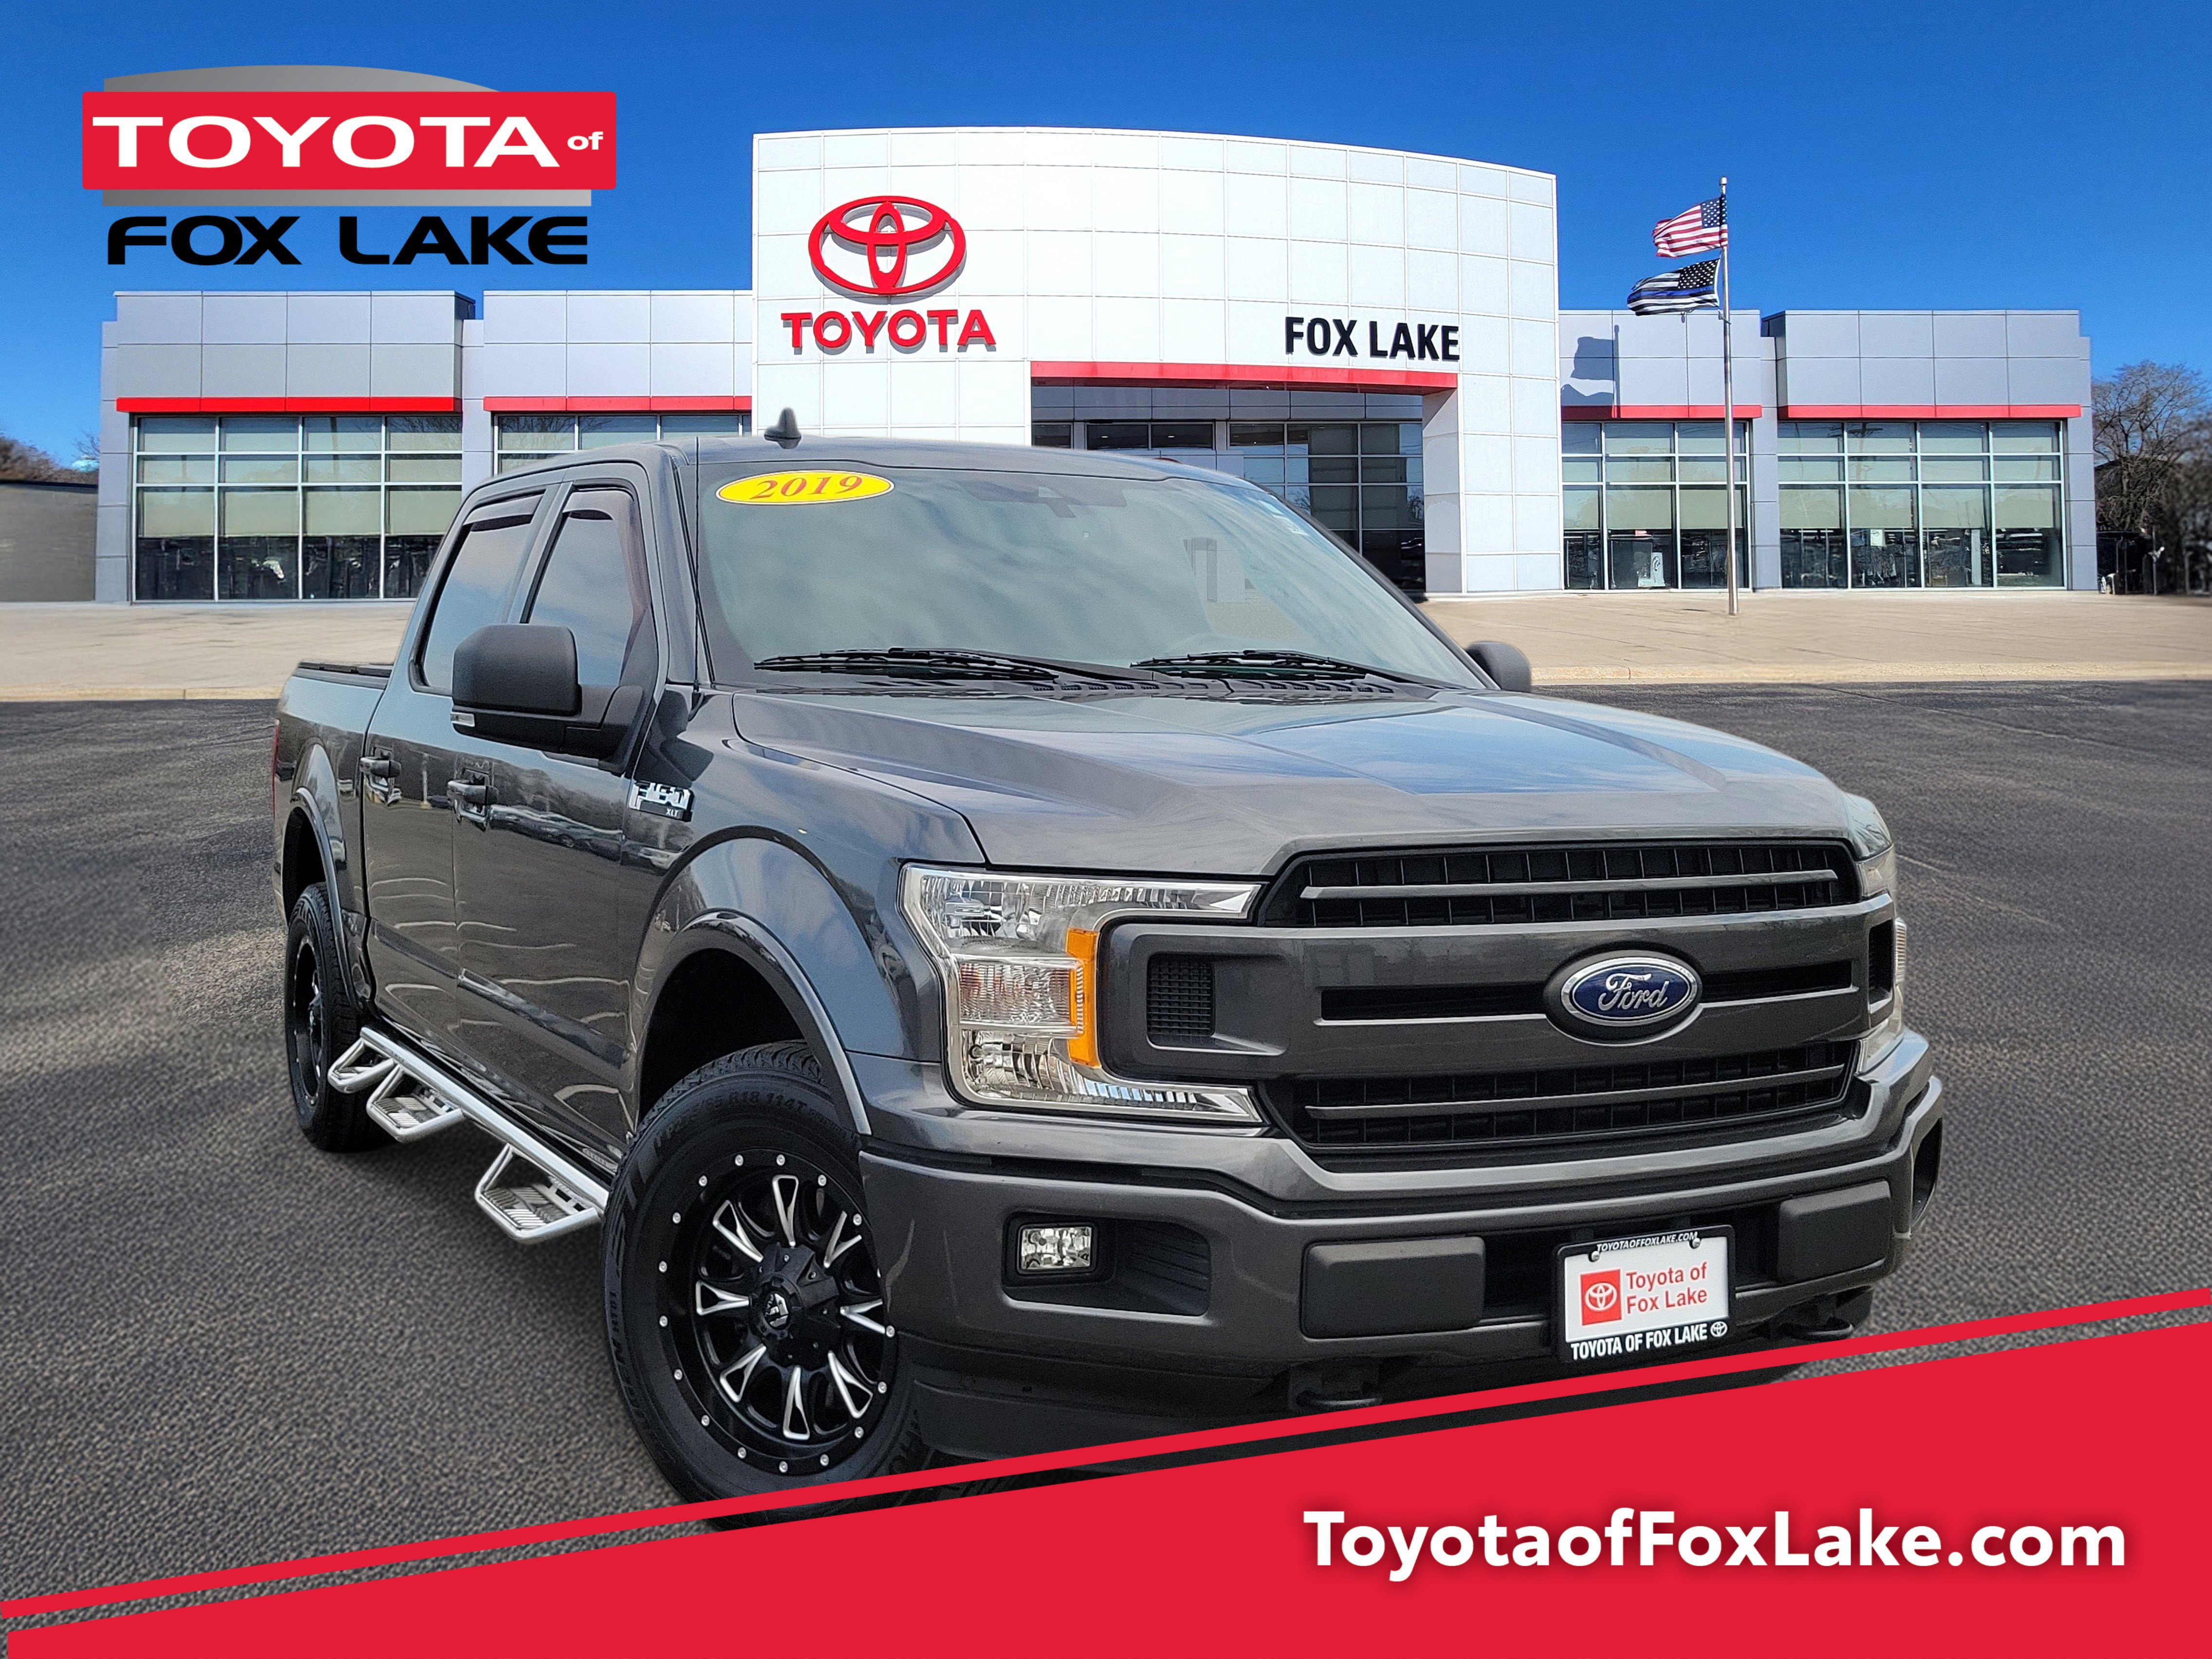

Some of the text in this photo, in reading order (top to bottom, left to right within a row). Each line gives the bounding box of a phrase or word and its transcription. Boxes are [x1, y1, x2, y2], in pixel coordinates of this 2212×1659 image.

[781, 309, 996, 350] TOYOTA
[1285, 316, 1461, 362] FOX LAKE
[750, 475, 863, 500] 2019
[666, 808, 679, 818] XLT
[1597, 973, 1670, 1011] Ford
[1596, 1231, 1698, 1252] TOYOTAOFFOXLAKE.COM
[1626, 1261, 1708, 1292] Toyota of
[1626, 1286, 1708, 1314] Fox Lake
[1571, 1323, 1708, 1361] TOYOTA OF FOX LAKE
